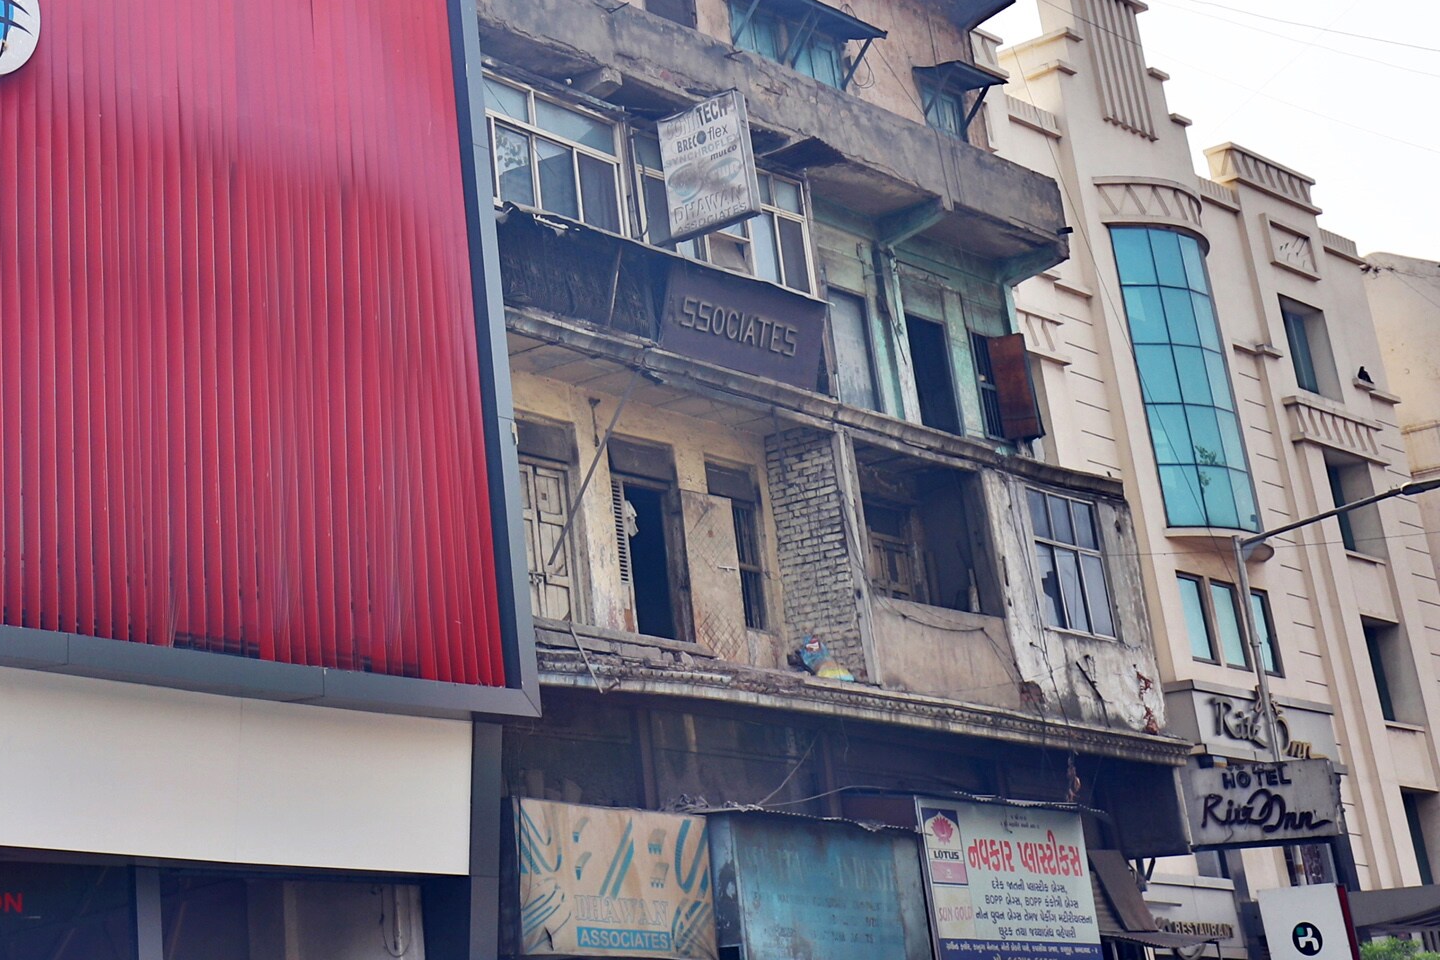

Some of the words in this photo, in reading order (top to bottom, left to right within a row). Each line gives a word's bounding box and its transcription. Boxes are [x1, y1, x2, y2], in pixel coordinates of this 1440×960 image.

[679, 296, 799, 357] SSOCIATES
[1222, 764, 1291, 789] HOTEL
[933, 850, 960, 860] LOTUS
[968, 839, 1015, 872] નવકાર
[574, 895, 669, 928] DHAWAN
[985, 894, 1003, 905] BOPP
[1025, 896, 1042, 907] BOPP
[580, 929, 669, 949] ASSOCIATES
